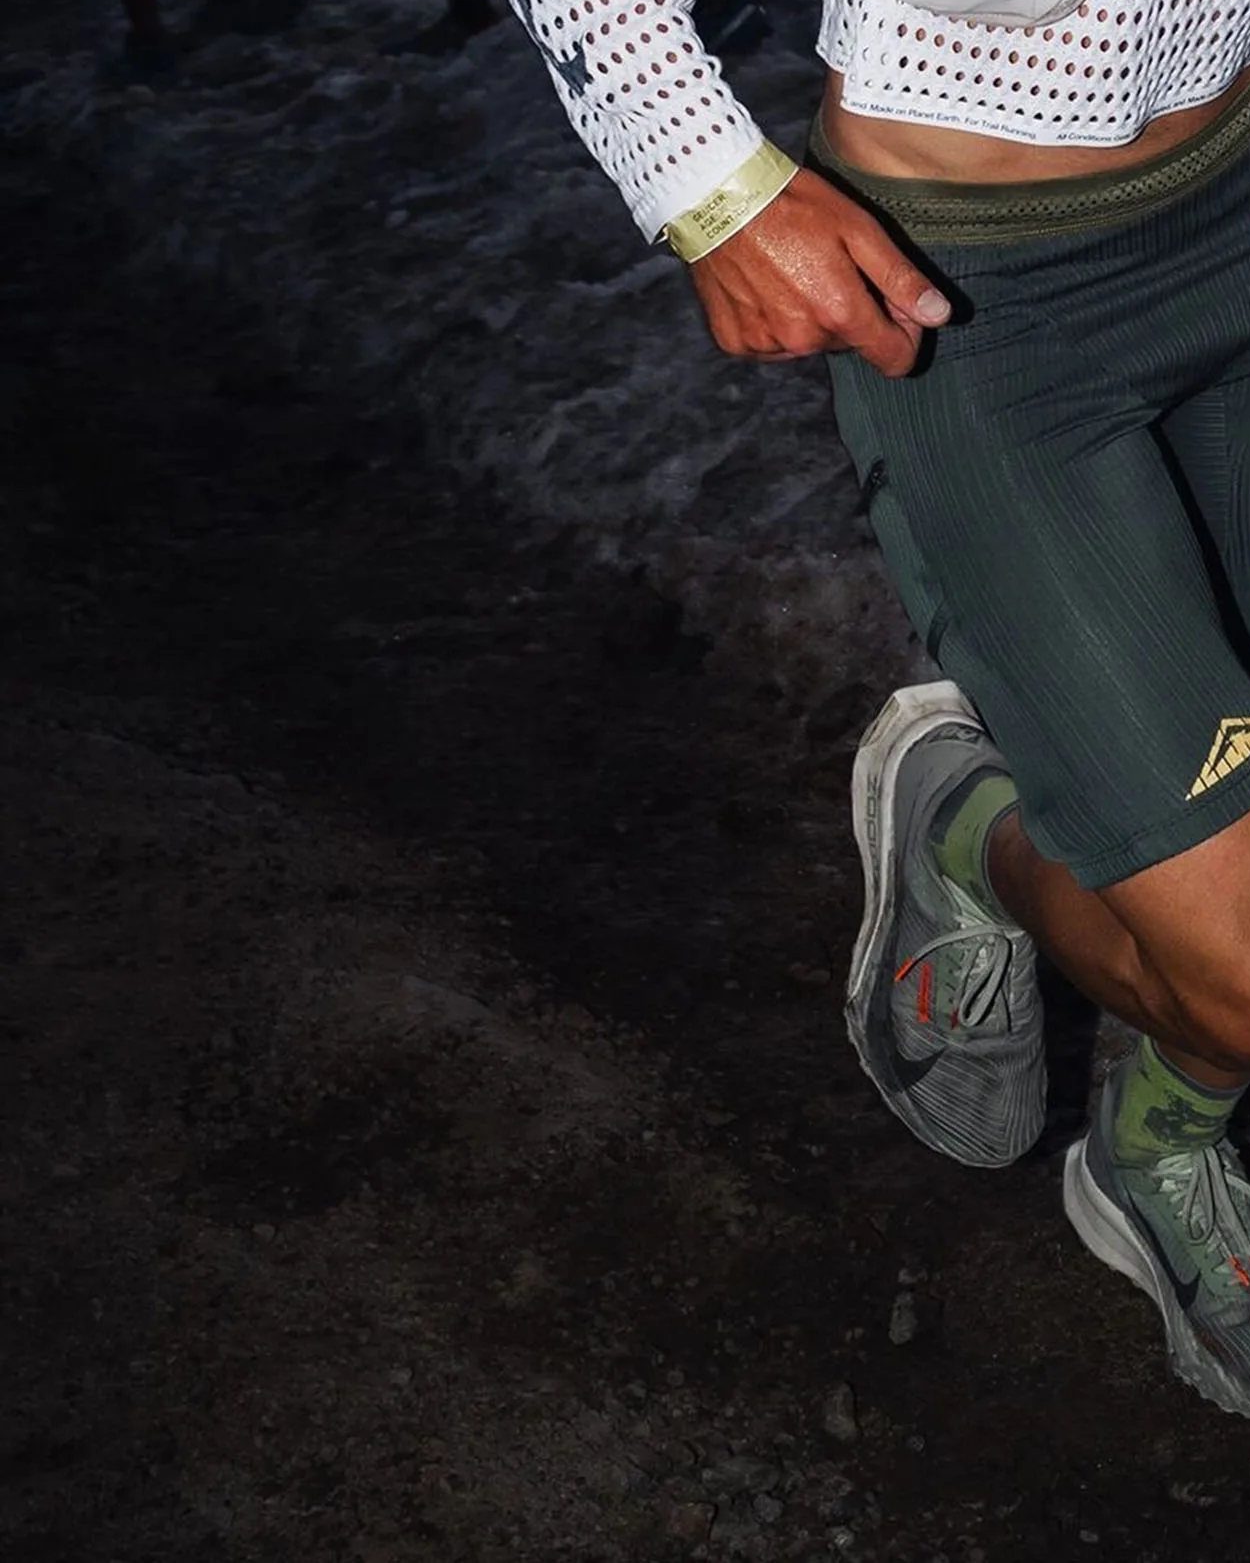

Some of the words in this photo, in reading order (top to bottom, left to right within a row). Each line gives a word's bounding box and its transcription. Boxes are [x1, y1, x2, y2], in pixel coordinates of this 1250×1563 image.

[870, 104, 893, 114] Made
[908, 108, 935, 119] Planet
[964, 117, 979, 126] For
[982, 119, 999, 130] Trail
